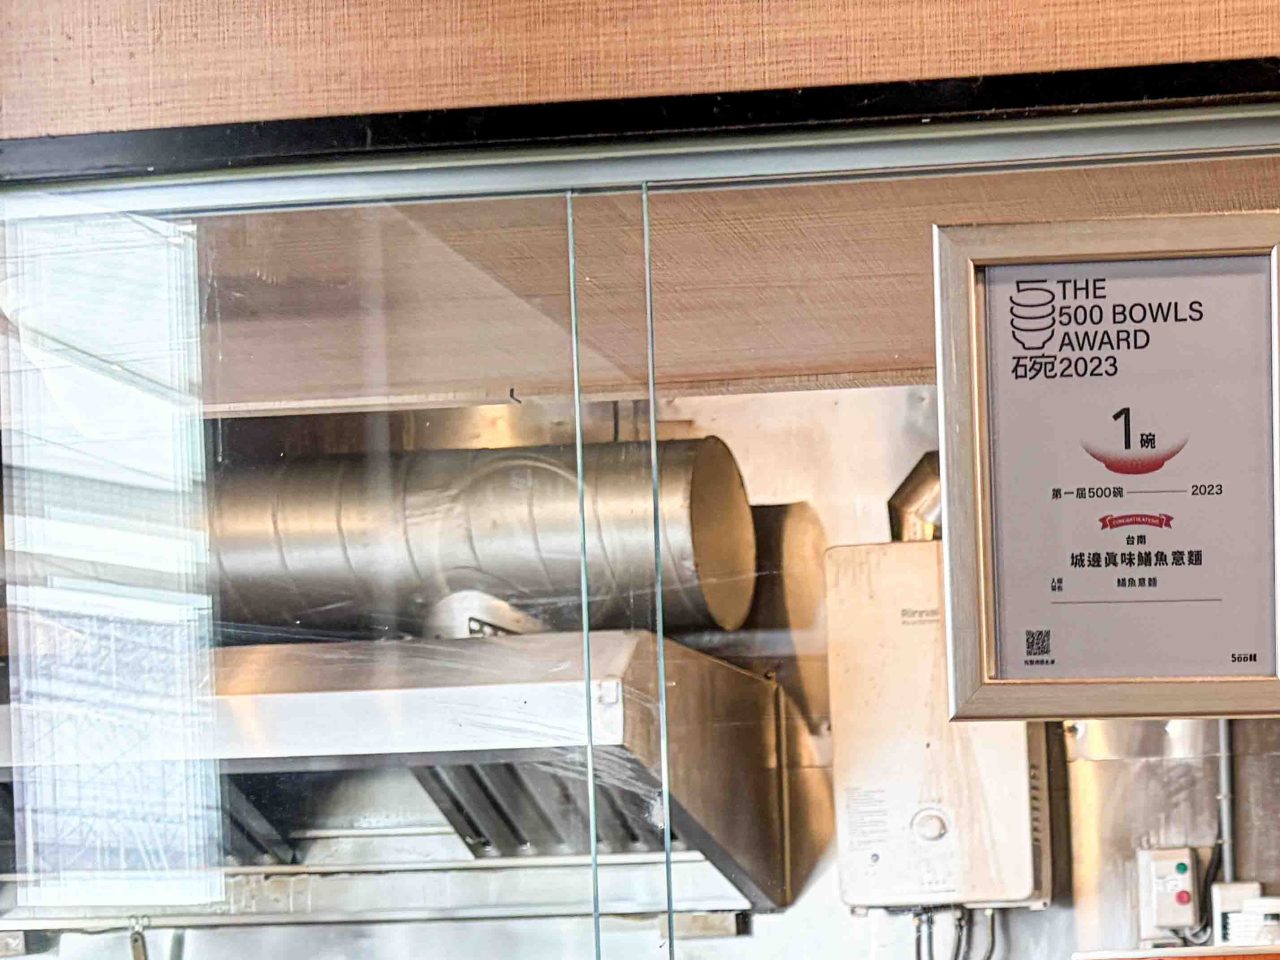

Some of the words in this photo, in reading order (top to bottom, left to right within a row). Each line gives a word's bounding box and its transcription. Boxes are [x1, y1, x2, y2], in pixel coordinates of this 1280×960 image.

[1057, 278, 1107, 300] THE
[1058, 304, 1104, 327] 500
[1112, 301, 1204, 325] BOWLS
[1058, 329, 1151, 352] AWARD
[1191, 484, 1223, 496] 2023
[1126, 534, 1147, 546] 台南
